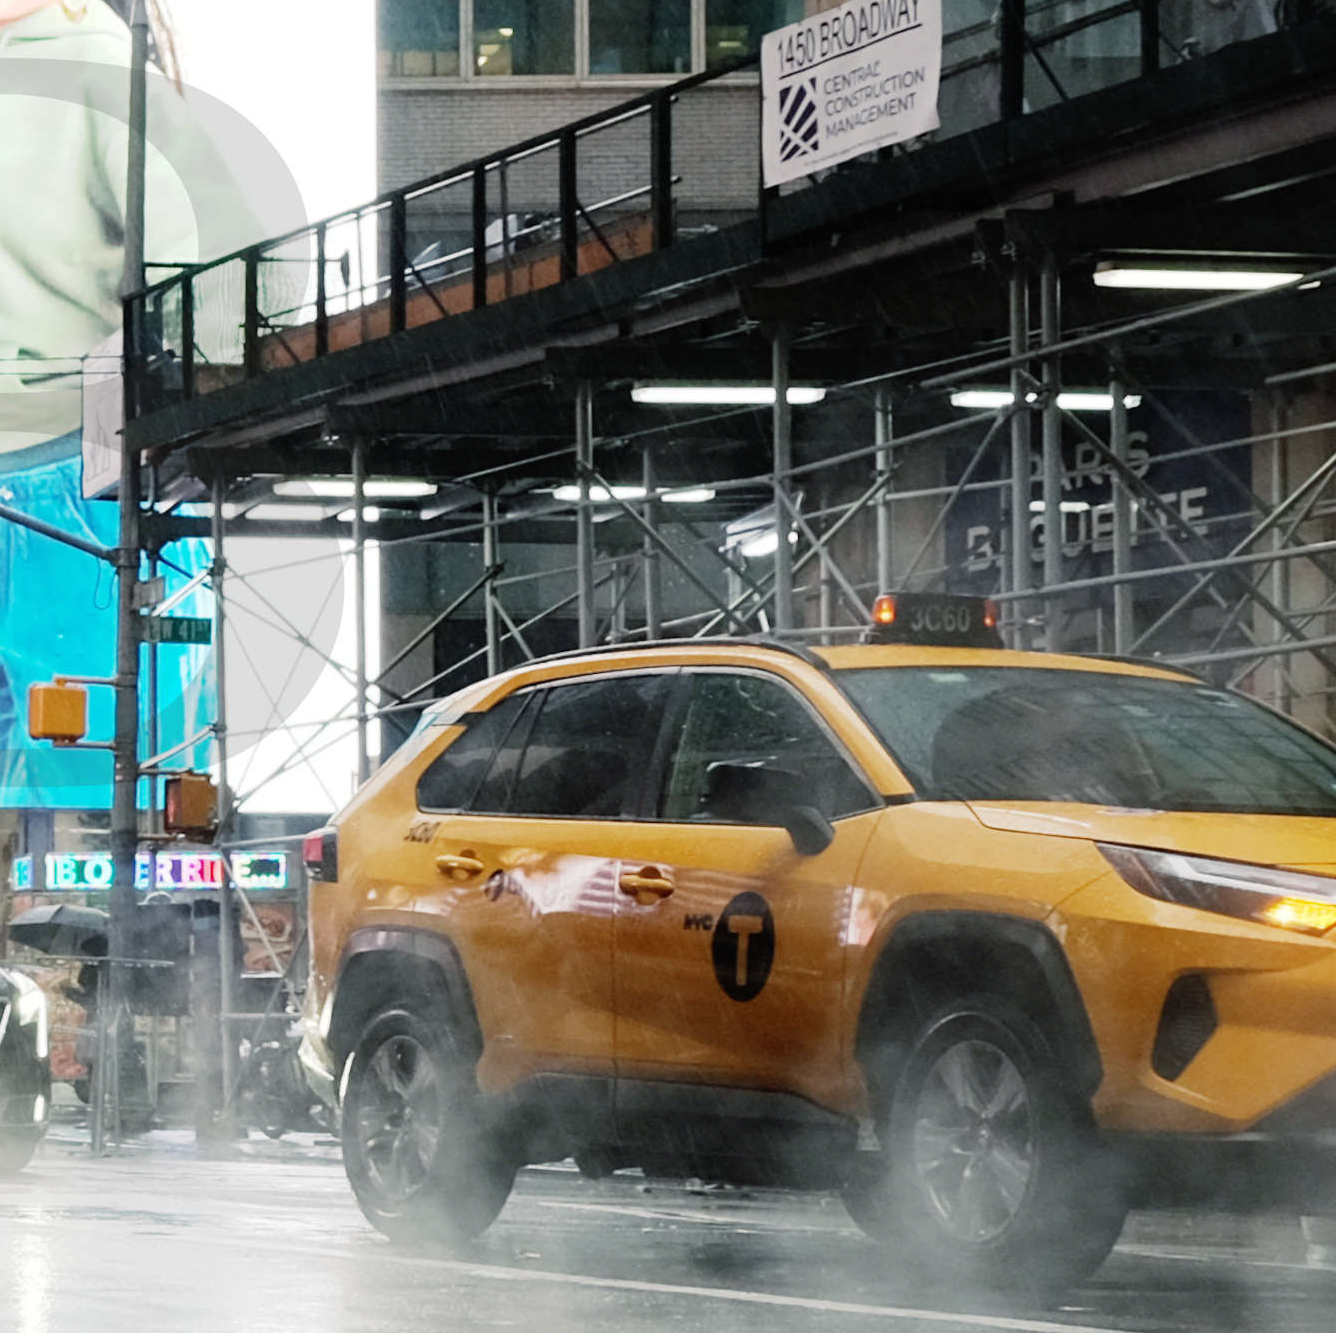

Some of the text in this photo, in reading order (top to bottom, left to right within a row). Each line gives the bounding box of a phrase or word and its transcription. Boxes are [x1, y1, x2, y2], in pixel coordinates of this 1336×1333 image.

[777, 28, 816, 74] 1450
[824, 60, 882, 95] CENTRAL
[824, 67, 926, 116] CONSTRUCTION
[825, 93, 917, 139] MANAGEMENT
[910, 604, 971, 633] 3C60
[728, 914, 763, 987] T
